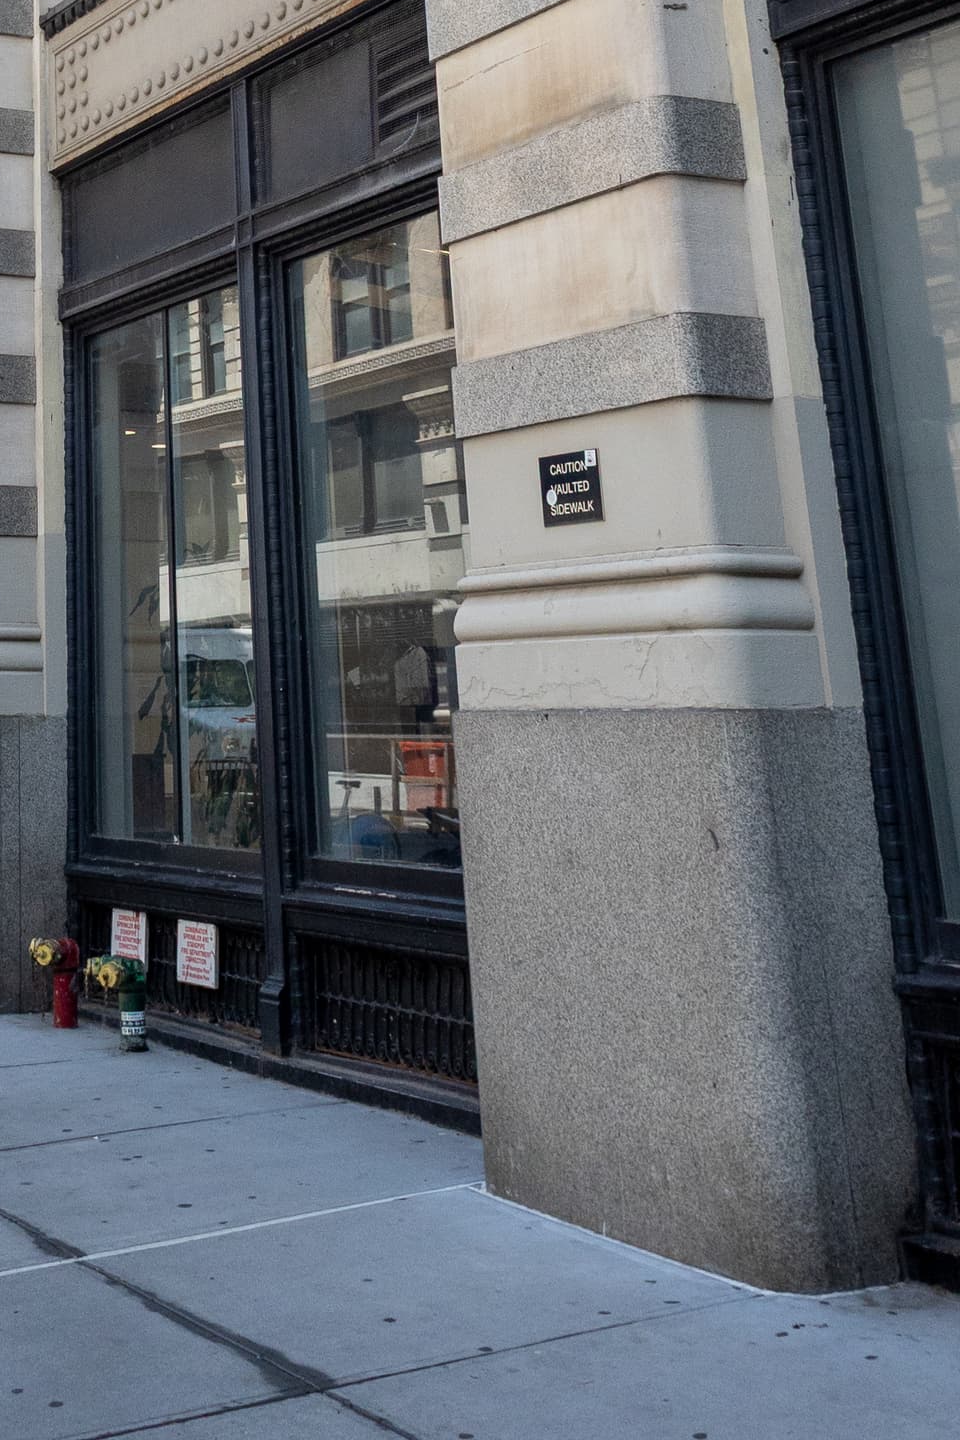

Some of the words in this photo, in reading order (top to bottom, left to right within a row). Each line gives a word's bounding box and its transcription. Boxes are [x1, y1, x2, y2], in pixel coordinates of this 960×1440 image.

[549, 460, 588, 476] CAUTION
[550, 480, 590, 495] VAULTED
[550, 500, 595, 516] SIDEWALK
